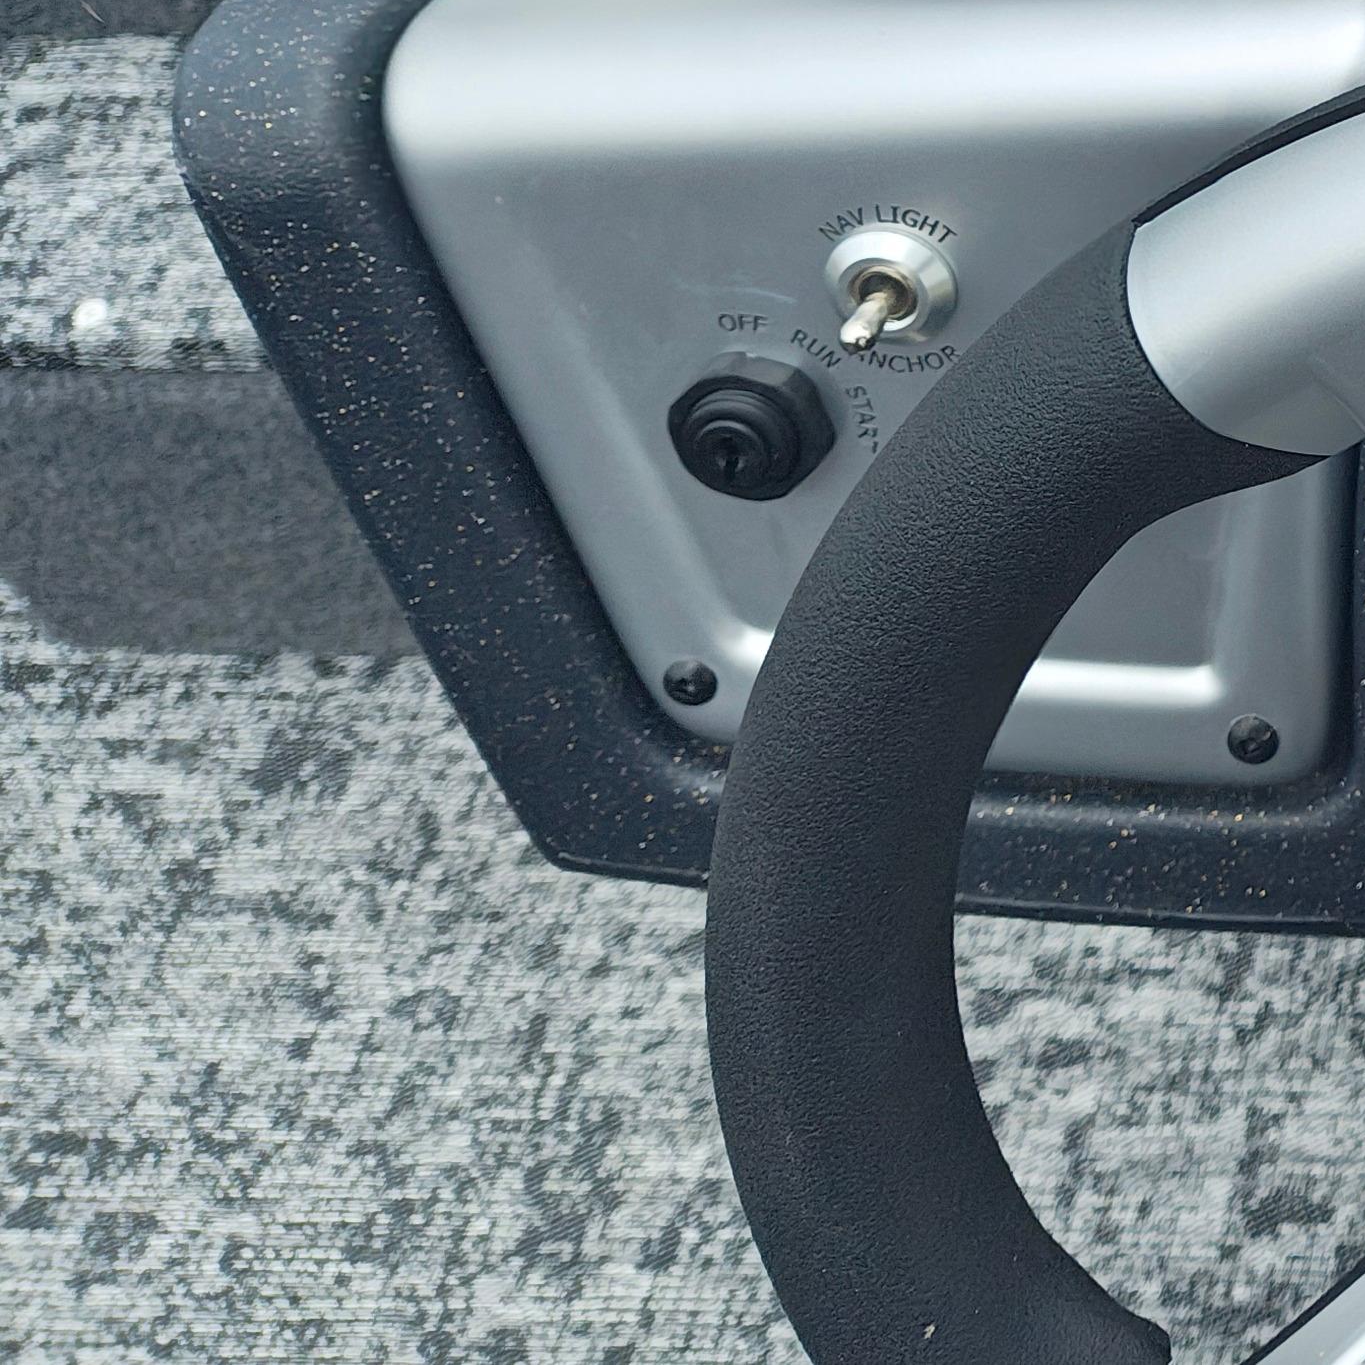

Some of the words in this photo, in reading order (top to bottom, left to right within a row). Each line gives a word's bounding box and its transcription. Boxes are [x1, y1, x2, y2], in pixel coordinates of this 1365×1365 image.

[819, 207, 865, 242] NAV
[875, 204, 958, 244] LIGHT
[717, 313, 769, 332] OFF
[790, 329, 841, 369] RUN
[858, 344, 962, 373] NCHOR
